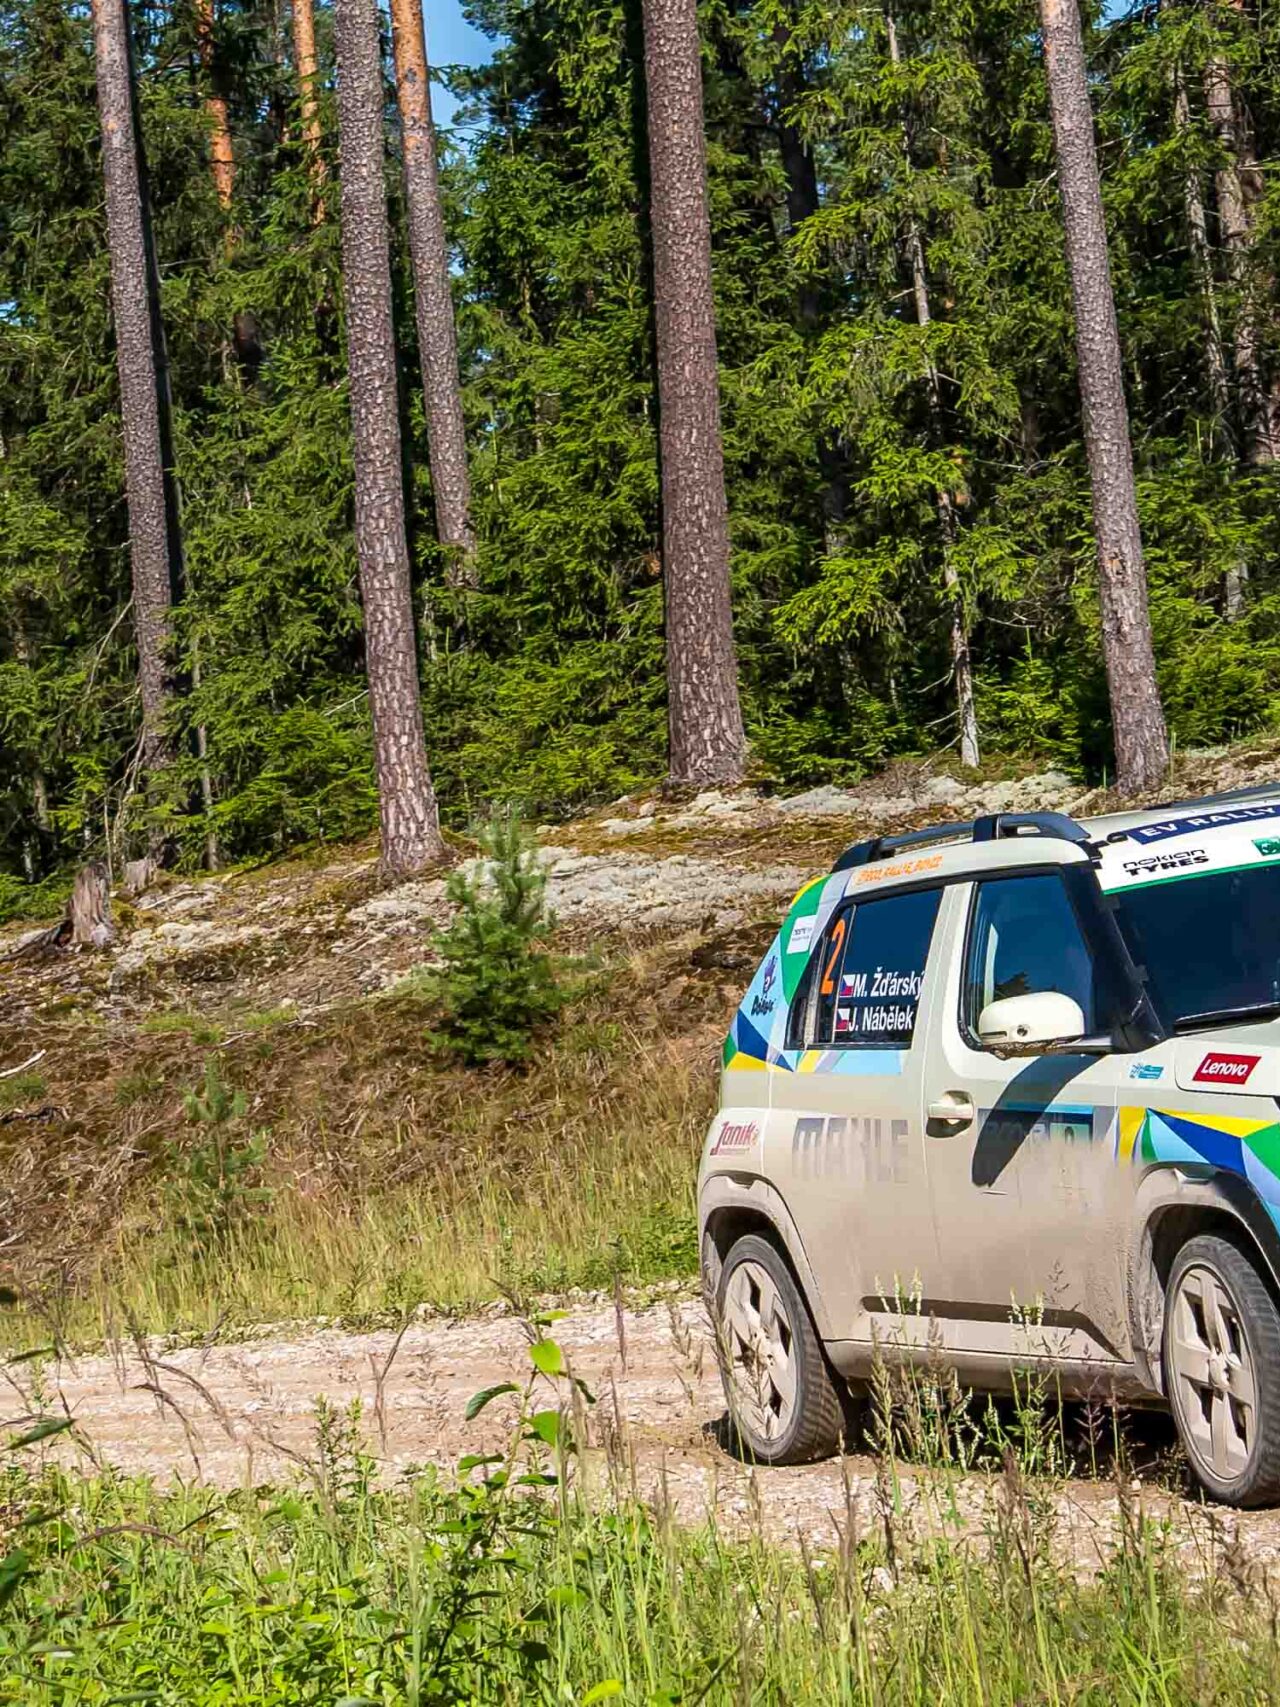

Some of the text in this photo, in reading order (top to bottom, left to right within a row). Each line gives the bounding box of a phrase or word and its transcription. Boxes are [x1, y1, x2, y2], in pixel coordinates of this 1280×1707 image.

[1140, 823, 1179, 837] EV
[1187, 806, 1277, 826] RALLY
[1123, 849, 1206, 869] nokian
[1125, 855, 1210, 876] TYRES
[820, 918, 846, 995] 2
[853, 966, 926, 1001] M. Žďárský
[848, 1005, 915, 1032] J. Nábělek
[1200, 1058, 1249, 1076] Lenovo
